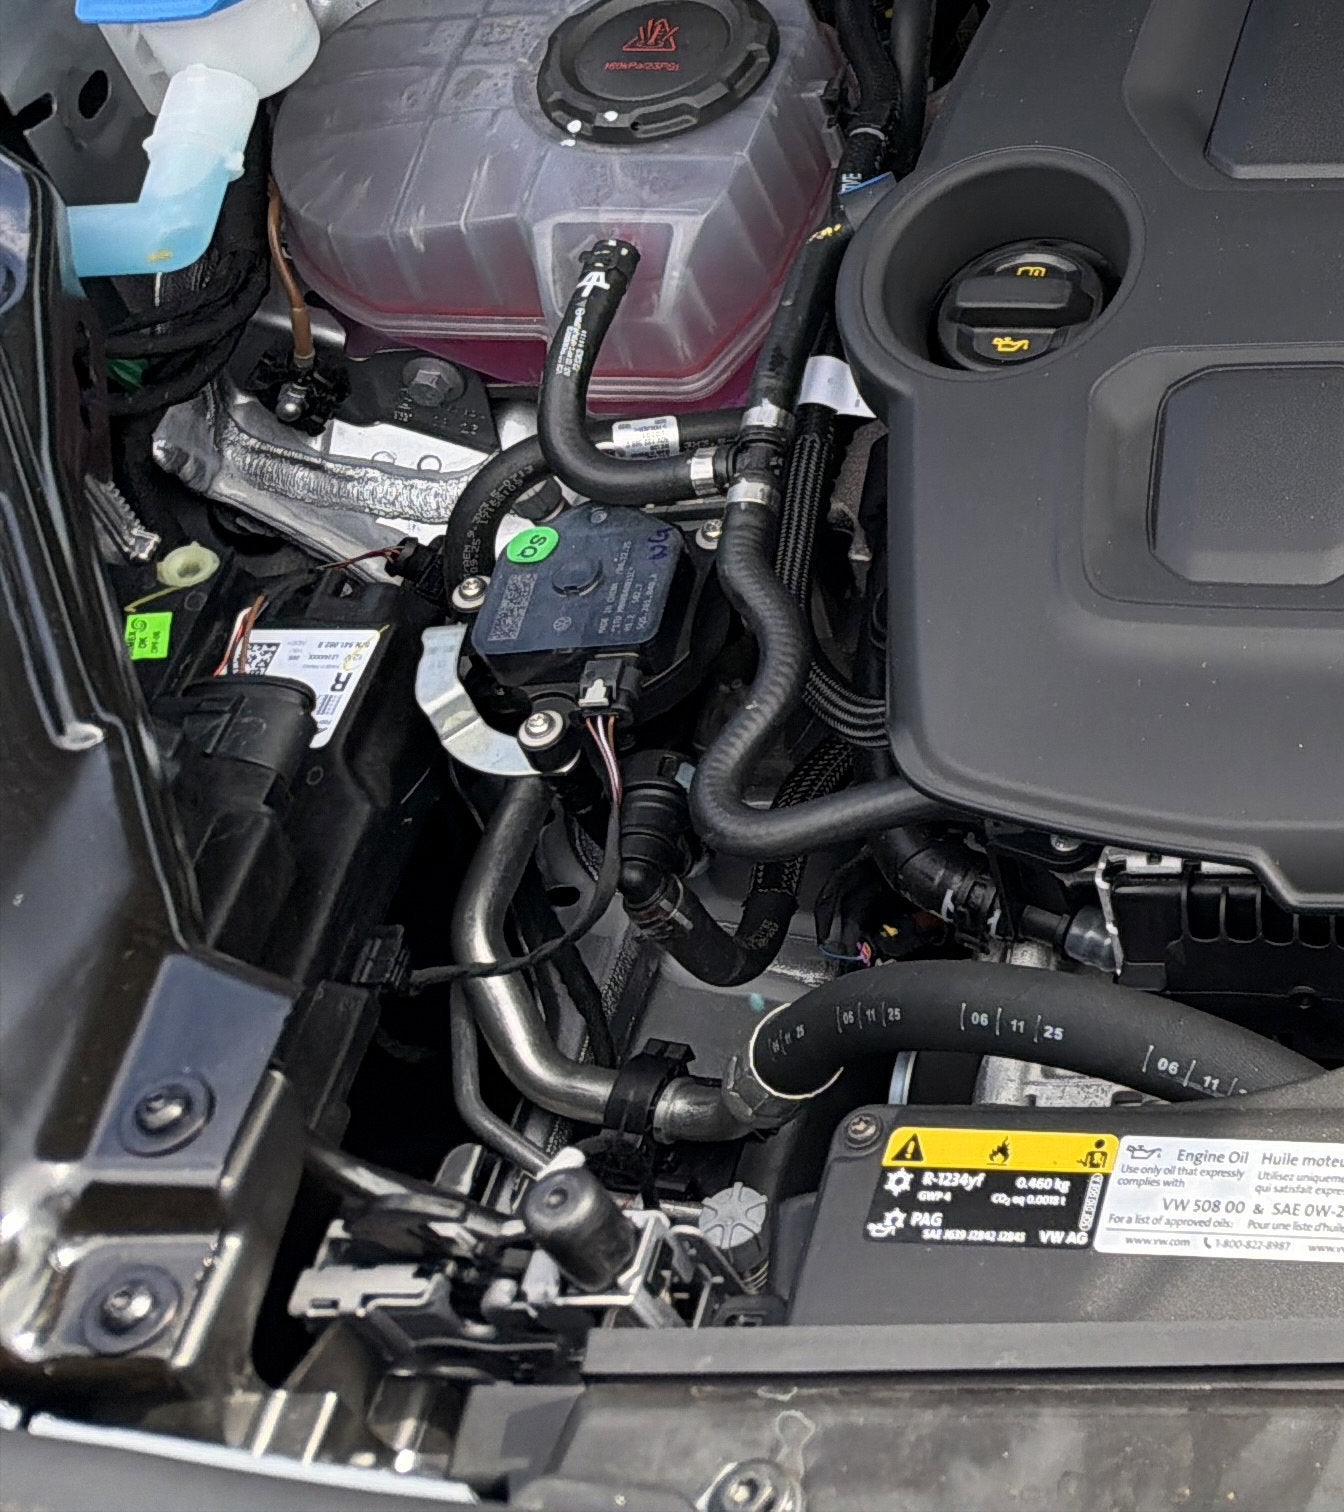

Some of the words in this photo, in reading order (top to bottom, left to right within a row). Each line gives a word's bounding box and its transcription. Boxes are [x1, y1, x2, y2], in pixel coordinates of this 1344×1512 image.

[330, 672, 346, 692] R
[866, 1009, 876, 1021] 11
[888, 1008, 901, 1021] 25
[971, 1012, 989, 1026] 06
[1010, 1019, 1025, 1033] 11
[1043, 1025, 1064, 1040] 25
[1157, 1057, 1179, 1074] 06
[1202, 1075, 1220, 1090] 11
[1177, 1149, 1225, 1166] Engine
[1228, 1151, 1249, 1164] Oil
[1261, 1152, 1299, 1166] Huile
[1120, 1164, 1139, 1174] Use
[1142, 1166, 1162, 1176] only
[1163, 1165, 1176, 1175] oil
[1178, 1167, 1197, 1176] that
[1200, 1169, 1245, 1180] expressly
[1257, 1171, 1294, 1182] Utilisez
[922, 1172, 987, 1191] R-1234yf
[1055, 1177, 1071, 1193] kg
[1117, 1177, 1160, 1187] complies
[1162, 1178, 1185, 1187] with
[1254, 1185, 1272, 1195] qui
[1273, 1185, 1313, 1194] satisfait
[917, 1192, 942, 1201] GWP
[943, 1192, 952, 1202] 4
[1012, 1196, 1025, 1207] eq
[1162, 1198, 1189, 1211] VW
[1192, 1199, 1221, 1213] 508
[1224, 1201, 1246, 1214] 00
[1252, 1204, 1264, 1215] &
[1272, 1203, 1301, 1216] SAE
[910, 1212, 943, 1226] PAG
[1108, 1214, 1125, 1224] For
[1126, 1215, 1132, 1224] a
[1135, 1214, 1149, 1225] list
[1151, 1215, 1163, 1225] of
[1164, 1216, 1211, 1228] approved
[1247, 1220, 1271, 1230] Pour
[1271, 1221, 1290, 1231] une
[1292, 1222, 1313, 1232] liste
[921, 1229, 942, 1240] SAE
[1039, 1230, 1065, 1244] VW
[1065, 1232, 1088, 1245] AG
[1125, 1237, 1190, 1246] www.vw.com
